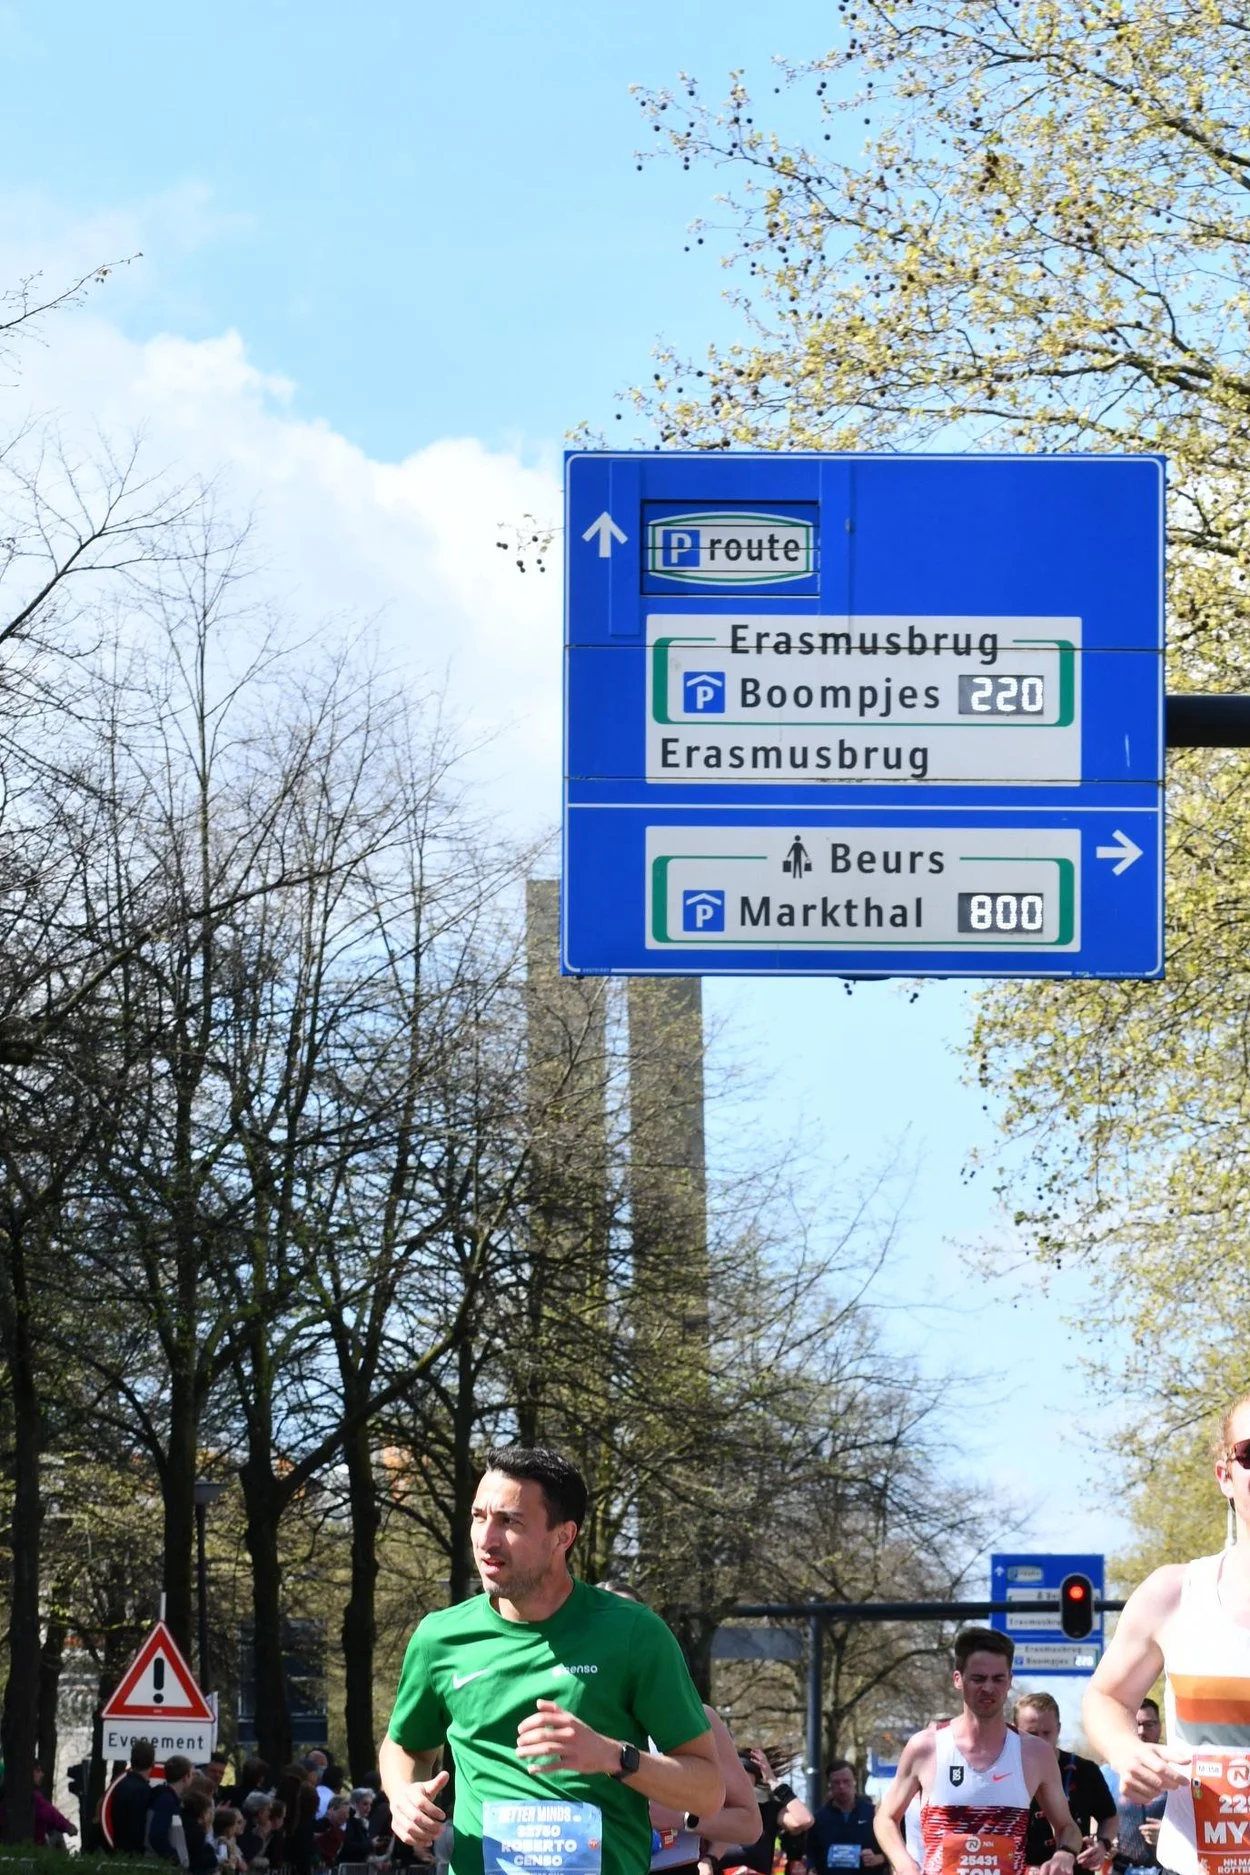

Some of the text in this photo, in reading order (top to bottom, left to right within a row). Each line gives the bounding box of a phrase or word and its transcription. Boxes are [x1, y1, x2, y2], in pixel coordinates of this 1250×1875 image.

[709, 533, 800, 562] route
[730, 624, 998, 666] Erasmusbrug
[740, 677, 940, 718] Boompjes
[970, 676, 1043, 712] 220
[660, 737, 929, 779] Erasmusbrug
[830, 843, 945, 875] Beurs
[739, 896, 923, 928] Markthal
[970, 894, 1043, 930] 800
[537, 1806, 572, 1822] MINDS
[501, 1839, 578, 1853] ROBERTO
[959, 1855, 998, 1866] 25431
[513, 1855, 563, 1867] CENSO
[1223, 1858, 1237, 1866] NN
